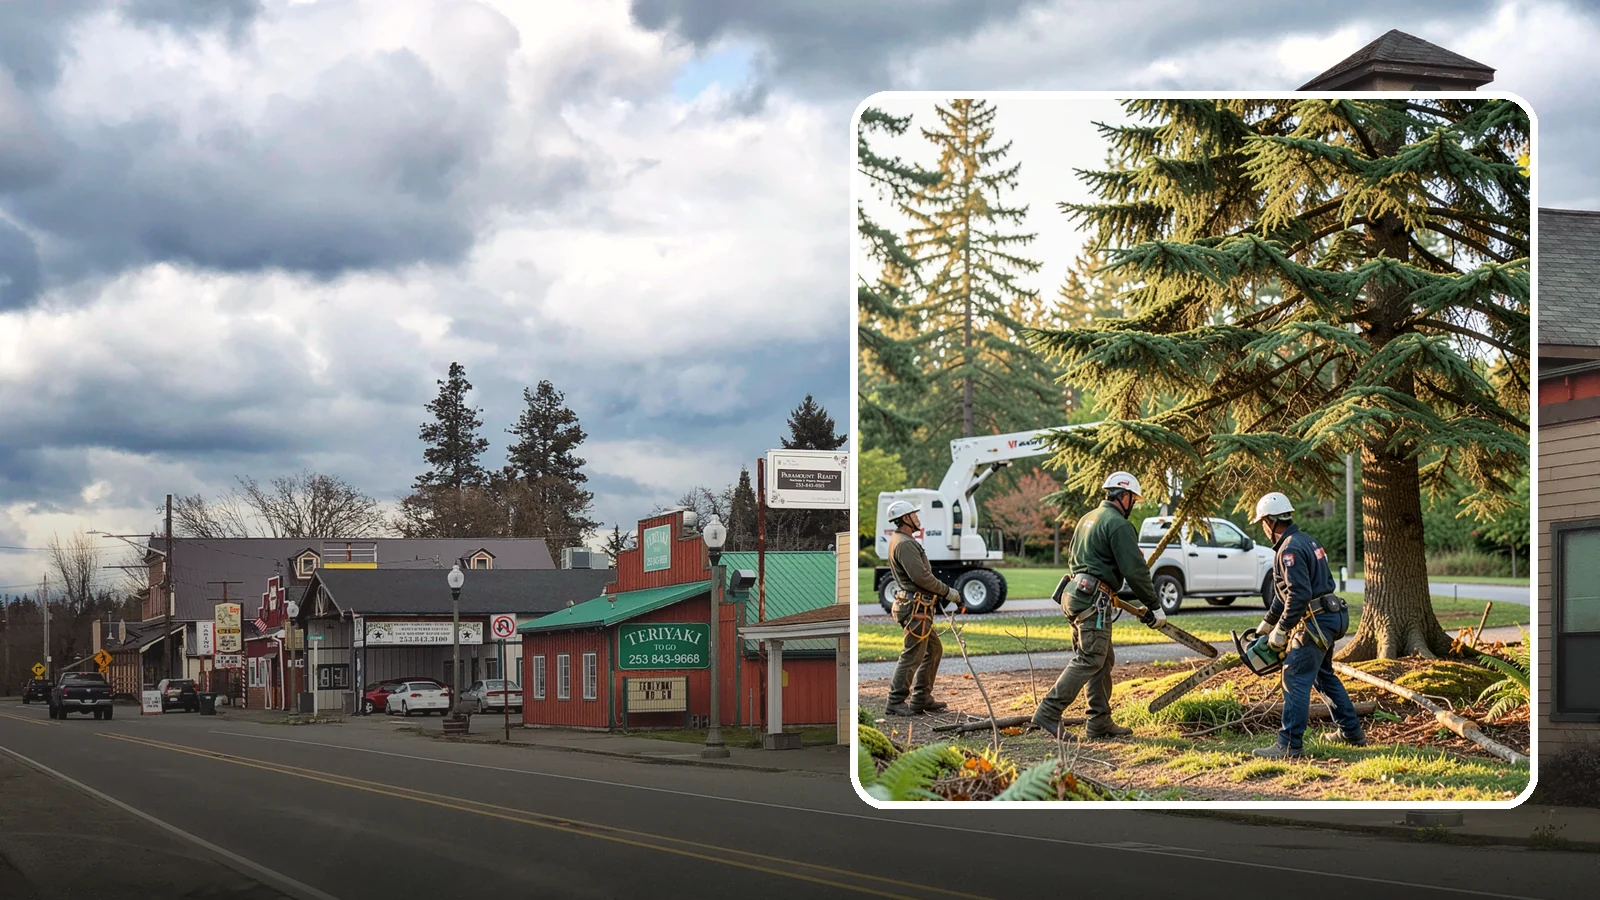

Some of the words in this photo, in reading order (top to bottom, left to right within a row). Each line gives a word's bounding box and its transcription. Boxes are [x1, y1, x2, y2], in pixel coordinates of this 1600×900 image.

[781, 471, 815, 479] PARAMOUNT
[817, 472, 839, 480] REALTY
[625, 627, 702, 646] TERIYAKI
[665, 643, 676, 651] GO
[628, 654, 648, 665] 253
[651, 653, 700, 664] 843-9668
